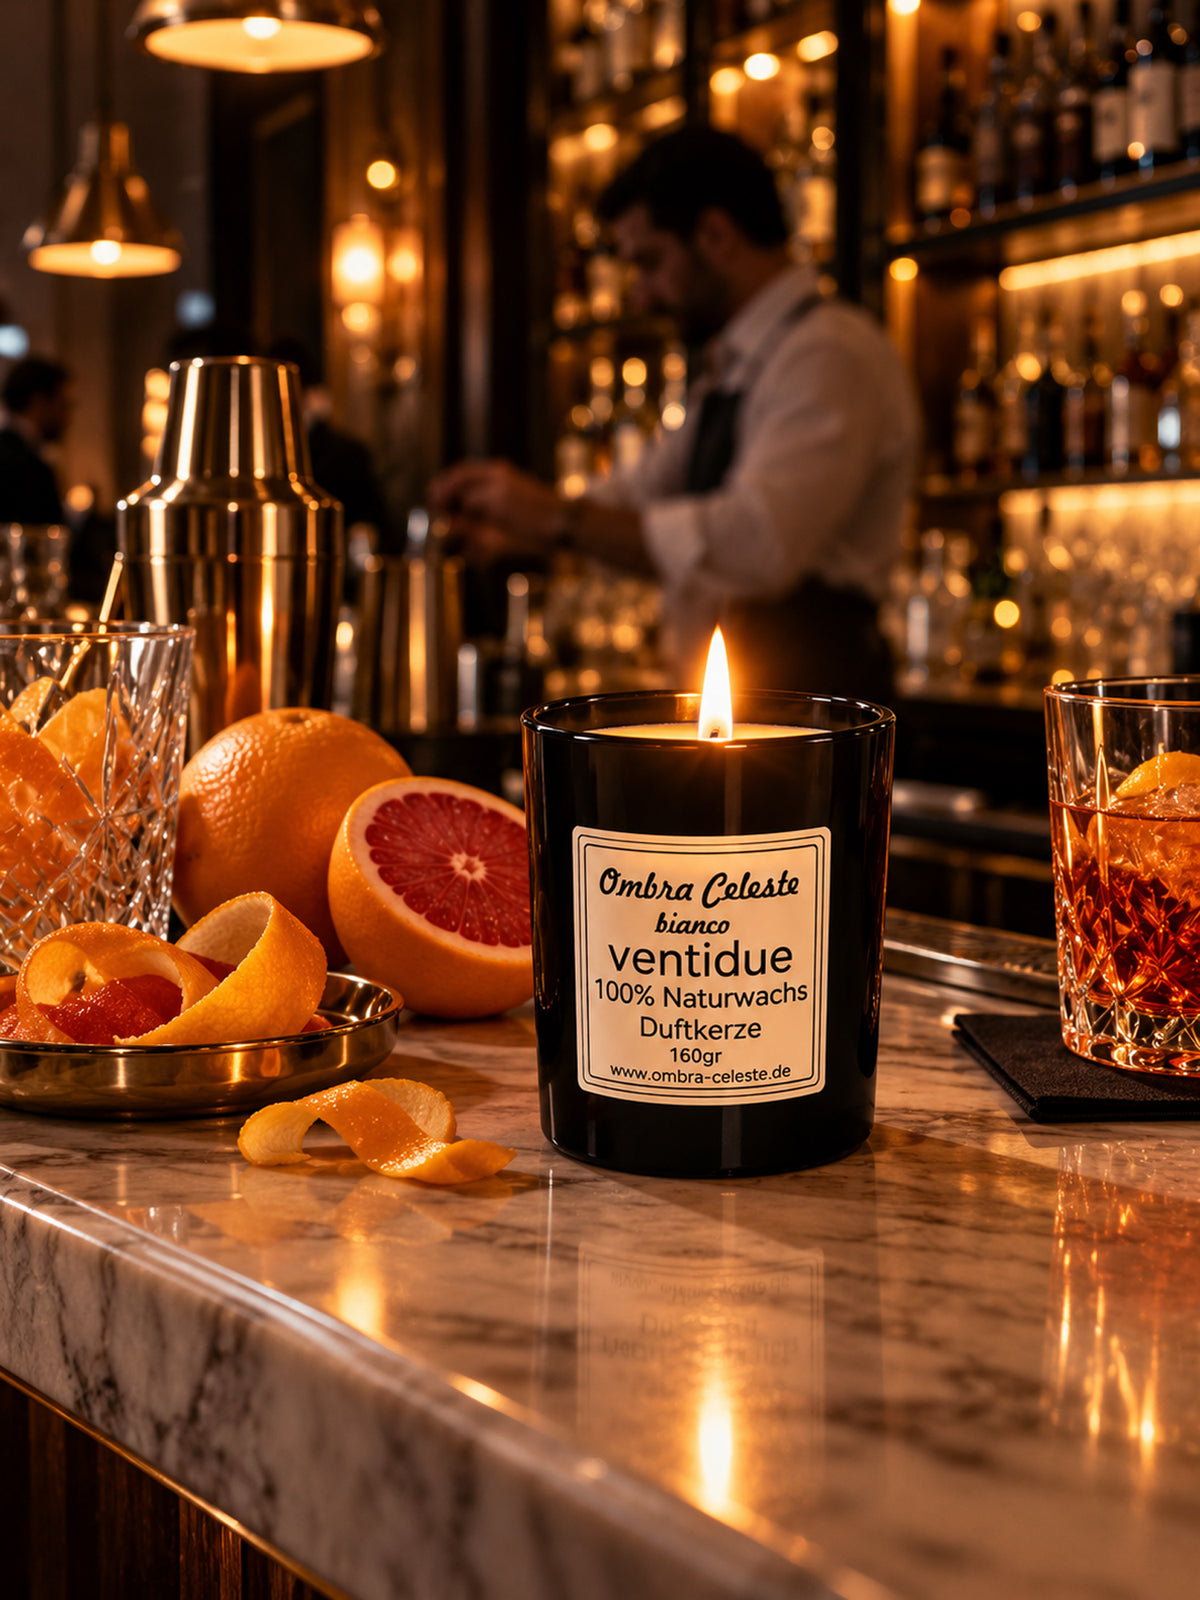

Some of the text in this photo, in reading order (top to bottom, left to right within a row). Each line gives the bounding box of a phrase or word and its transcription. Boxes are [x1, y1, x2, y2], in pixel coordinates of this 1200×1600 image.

[599, 867, 800, 909] Ombra Celeste
[654, 911, 731, 935] bianco
[607, 939, 793, 978] ventidue
[594, 978, 808, 1009] 100% Naturwachs
[640, 1015, 762, 1041] Duftkerze
[669, 1047, 723, 1068] 160gr
[609, 1064, 791, 1084] www.ombra-celeste.de
